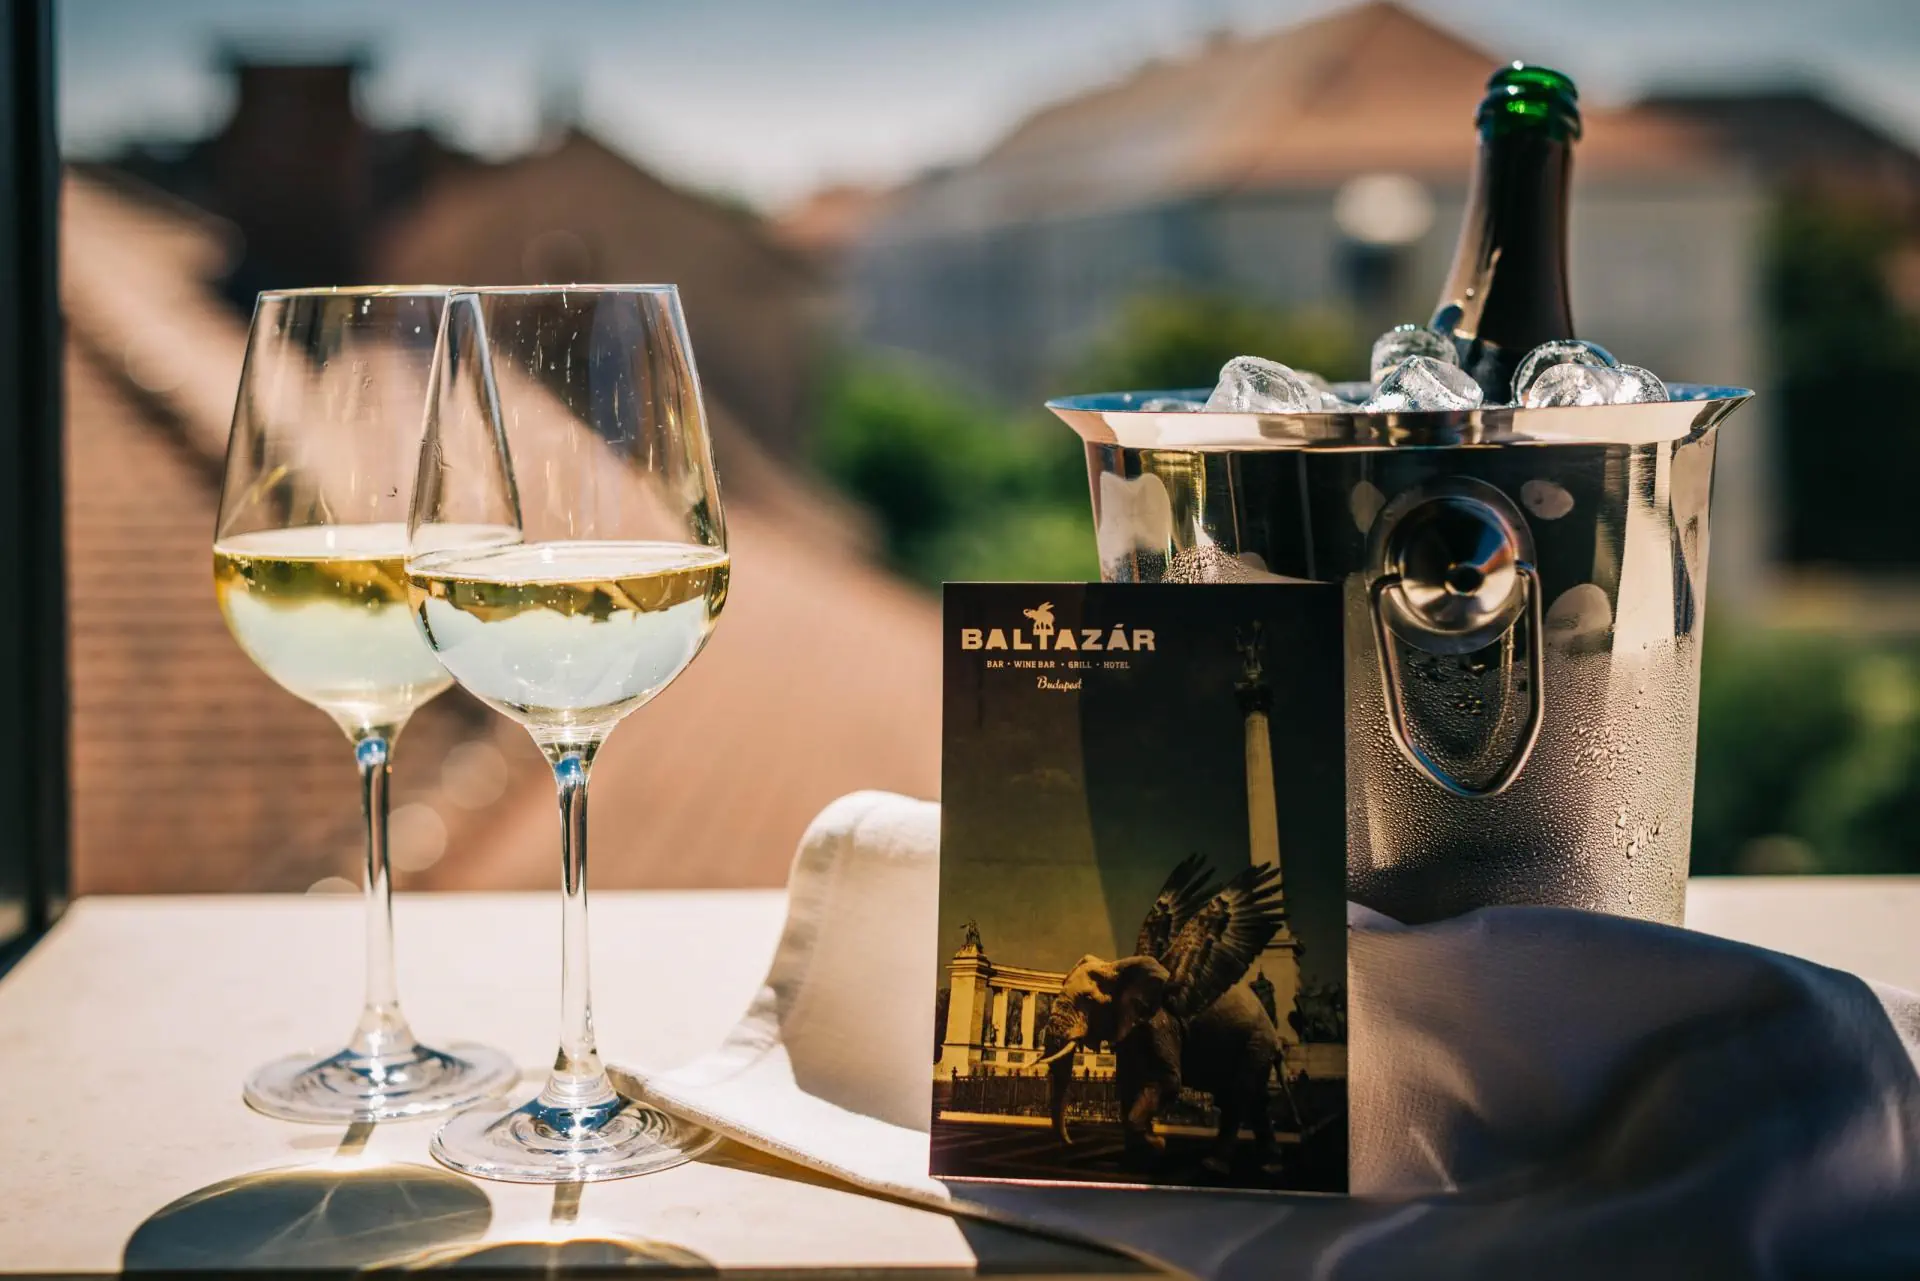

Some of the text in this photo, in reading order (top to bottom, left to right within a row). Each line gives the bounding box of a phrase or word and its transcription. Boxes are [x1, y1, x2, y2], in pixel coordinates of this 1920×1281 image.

[961, 623, 1156, 651] BALTAZÁR
[986, 659, 1005, 669] BAR
[1067, 659, 1093, 669] GRILL
[1103, 659, 1131, 669] HOTEL
[1036, 675, 1083, 693] Budapest
